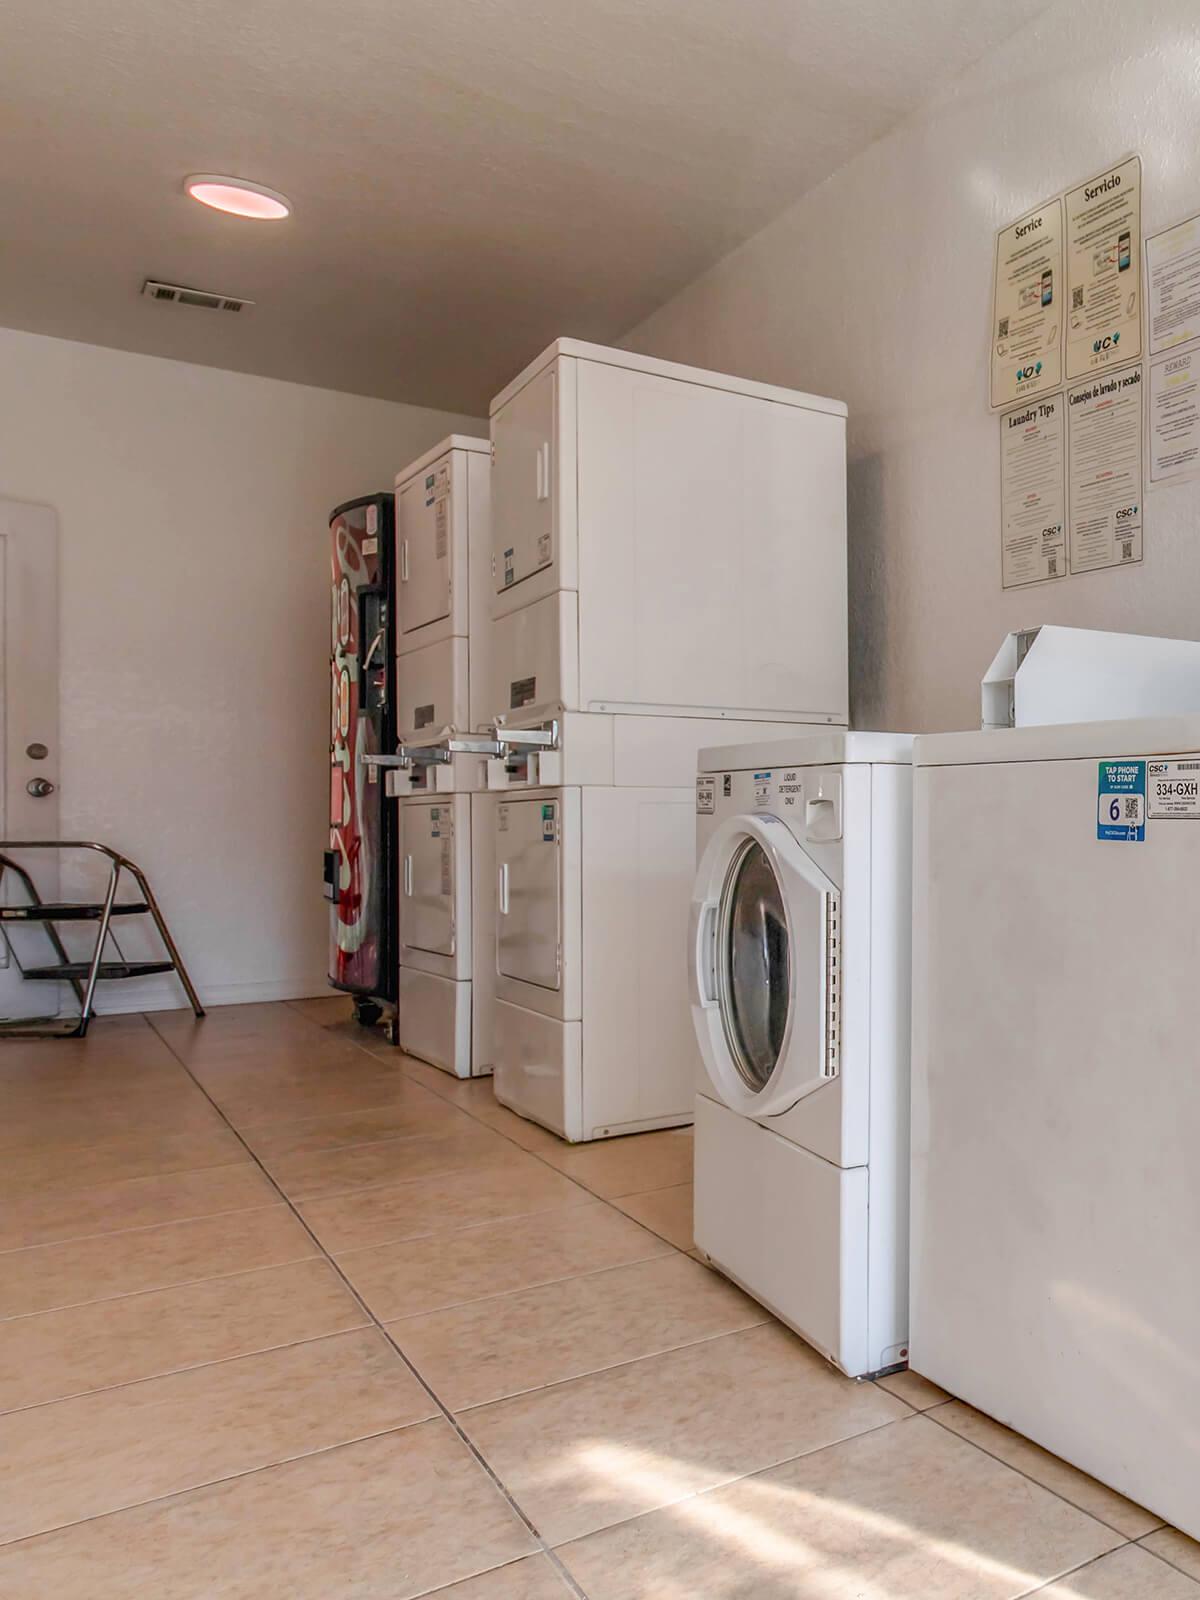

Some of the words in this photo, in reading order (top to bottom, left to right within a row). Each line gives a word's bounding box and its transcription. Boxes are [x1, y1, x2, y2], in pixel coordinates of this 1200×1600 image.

[1084, 175, 1121, 202] Servicio
[1015, 217, 1042, 240] Service
[1093, 385, 1099, 398] de
[1099, 379, 1117, 396] lavado
[1122, 371, 1141, 388] secado
[1009, 407, 1037, 428] Laundry
[1039, 403, 1055, 418] Tips
[1116, 507, 1133, 519] CSC
[1042, 526, 1057, 537] CSC
[1105, 766, 1117, 774] TAP
[1118, 766, 1139, 774] PHONE
[1150, 764, 1164, 772] CSC
[1108, 774, 1116, 782] TO
[1117, 774, 1136, 782] START
[1156, 782, 1198, 796] 334-GXH
[1109, 798, 1120, 821] 6
